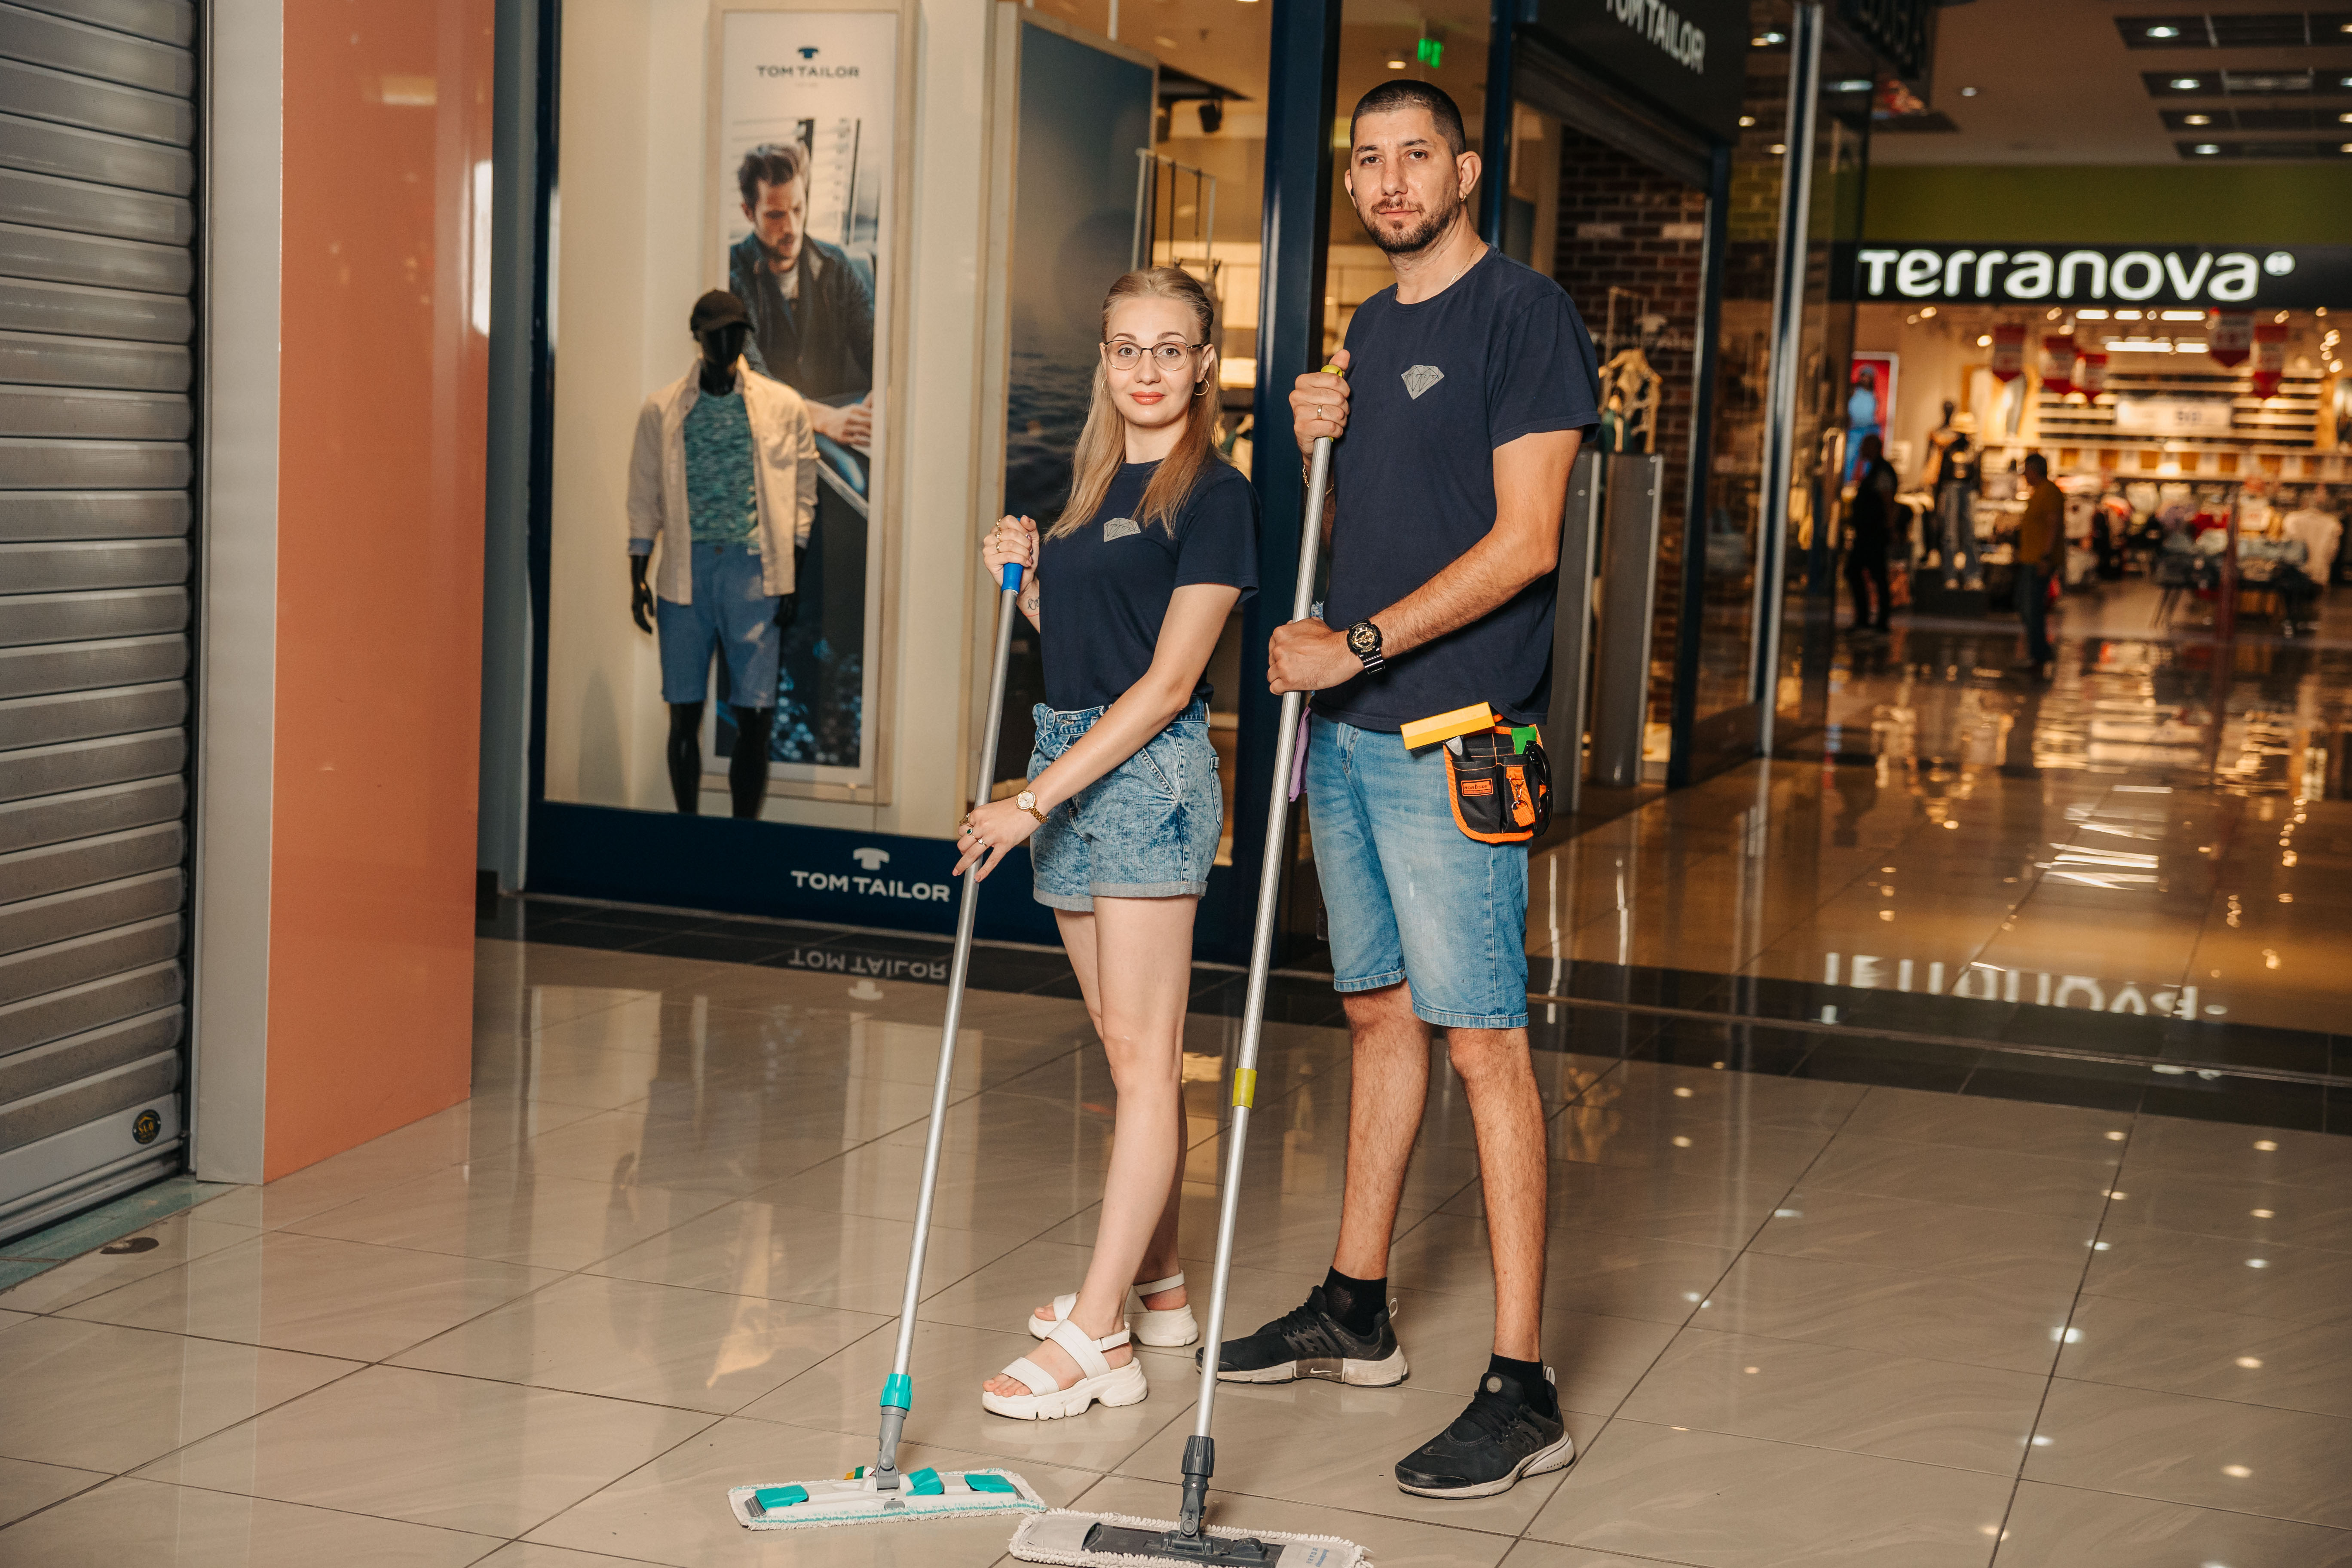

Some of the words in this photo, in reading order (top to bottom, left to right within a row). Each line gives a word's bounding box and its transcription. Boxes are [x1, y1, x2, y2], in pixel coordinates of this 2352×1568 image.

[1606, 0, 1645, 34] OM
[1644, 0, 1706, 75] TAILOR
[756, 65, 793, 77] TOM
[798, 65, 859, 78] TAILOR
[1858, 249, 2260, 301] Terranova
[790, 870, 849, 892] TOM
[852, 877, 950, 902] TAILOR
